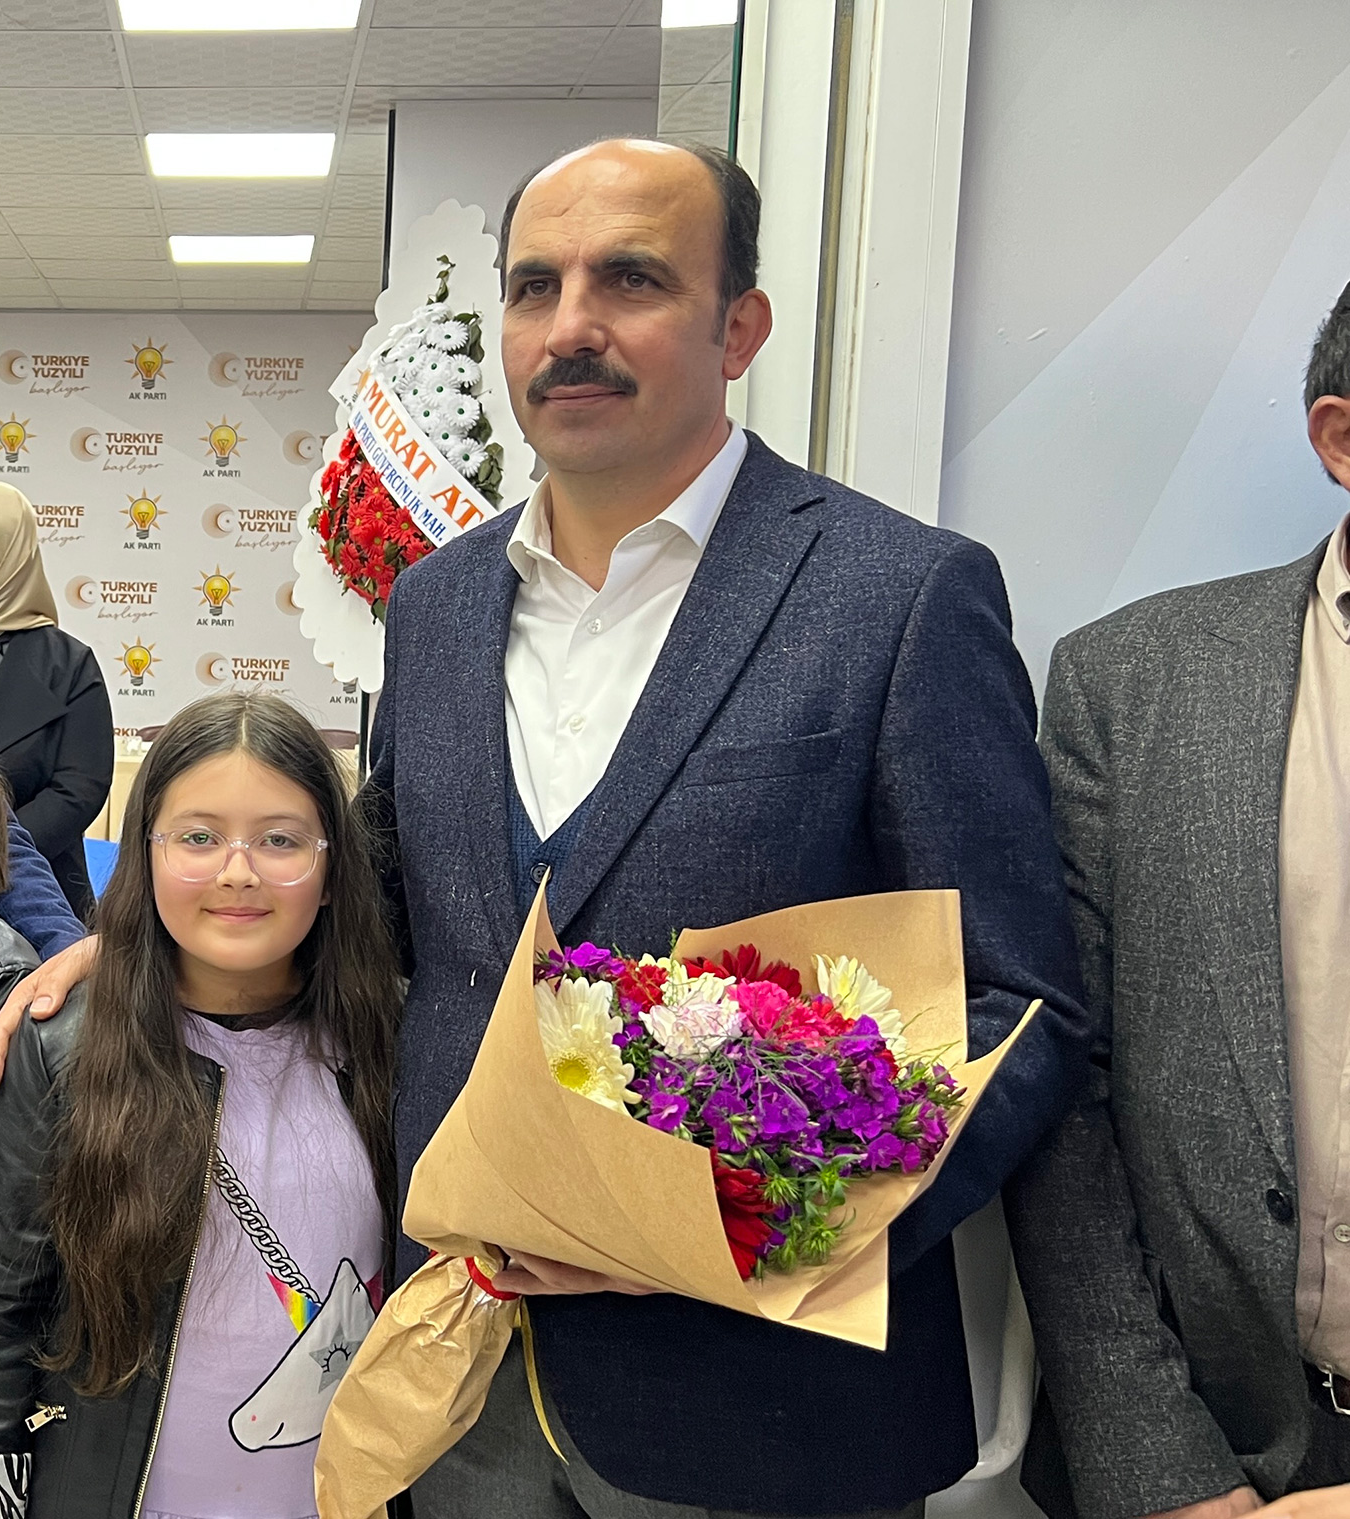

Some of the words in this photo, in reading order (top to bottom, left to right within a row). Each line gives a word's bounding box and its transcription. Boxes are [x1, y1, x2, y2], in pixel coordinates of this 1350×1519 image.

[363, 380, 437, 482] MURAT
[37, 517, 78, 528] UZYILI
[418, 508, 447, 541] MAH.
[196, 618, 209, 626] AK
